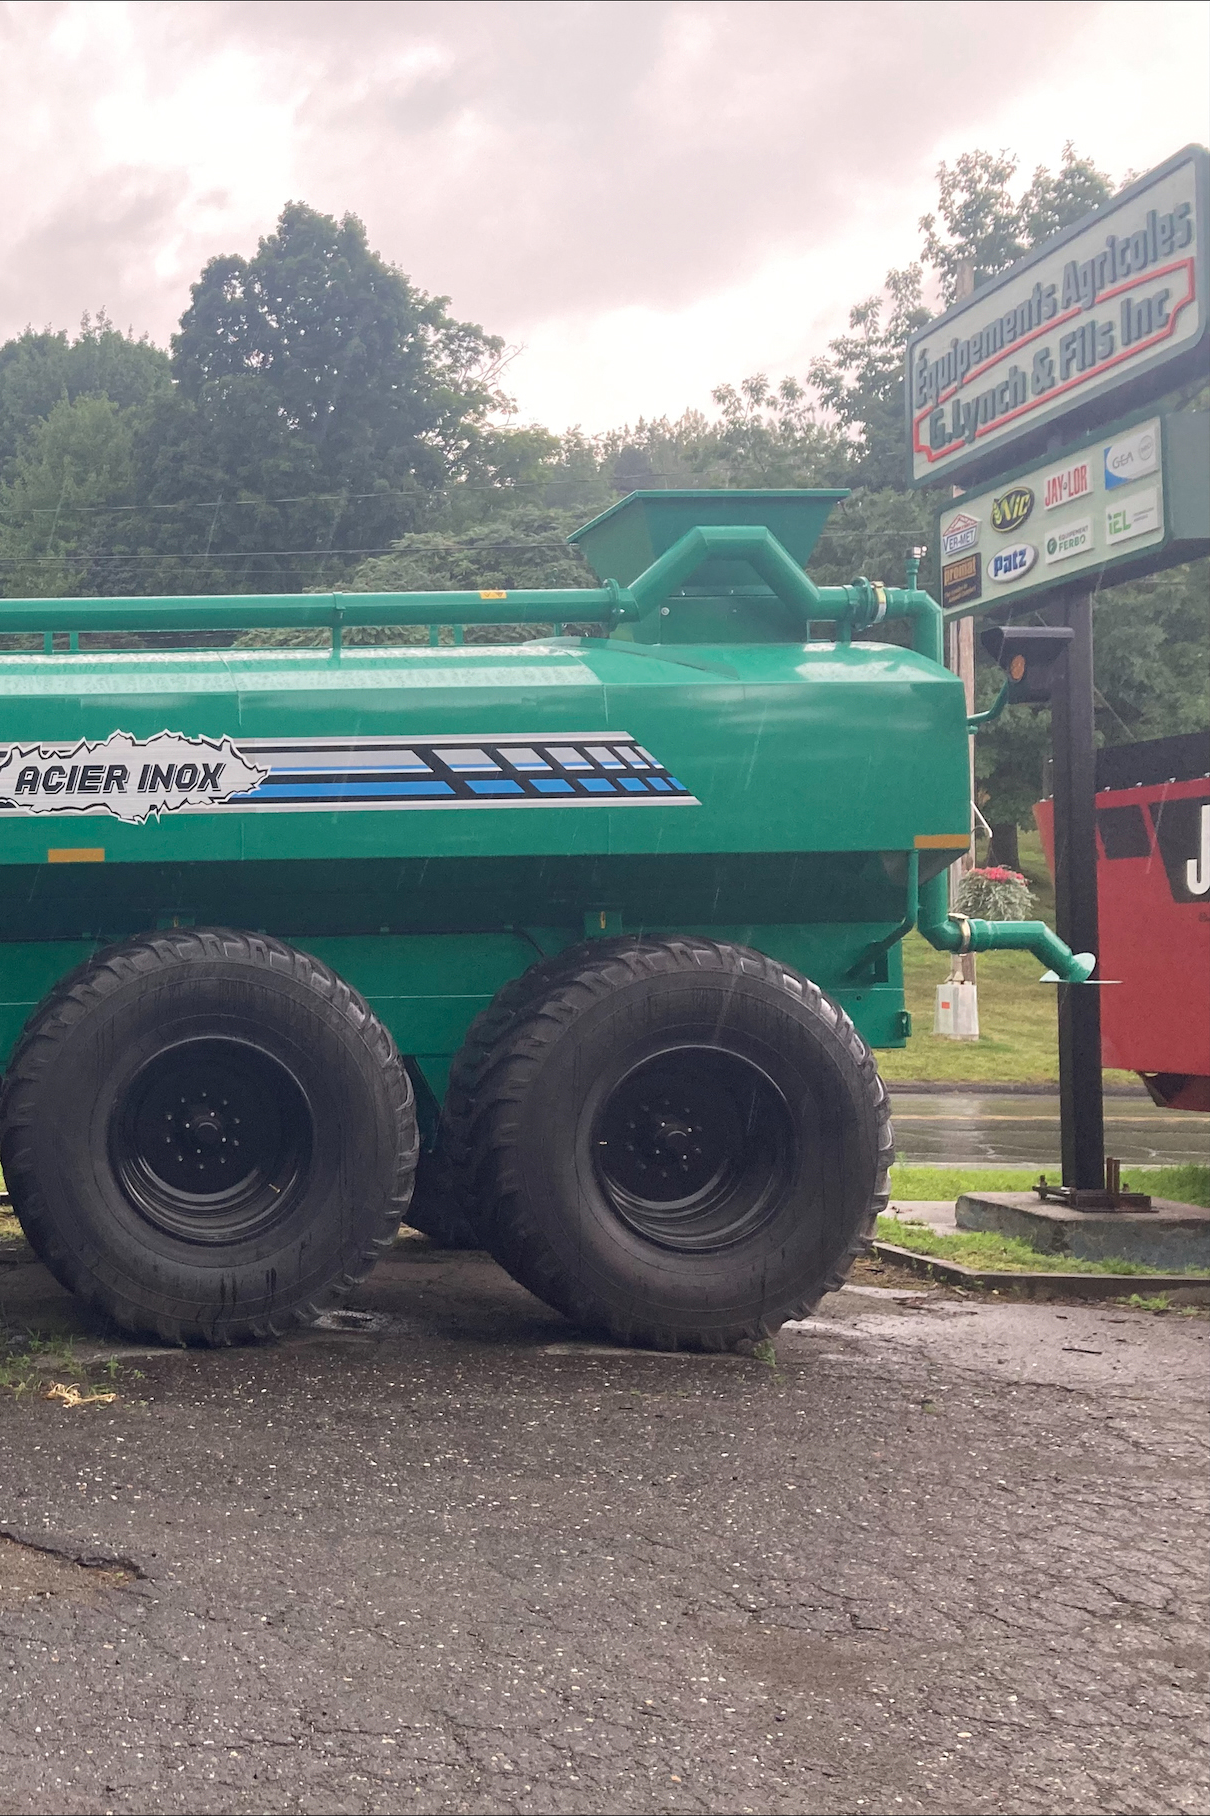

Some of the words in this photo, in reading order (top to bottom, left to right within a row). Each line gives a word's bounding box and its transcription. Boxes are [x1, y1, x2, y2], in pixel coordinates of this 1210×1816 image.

[915, 282, 1058, 409] Équipements
[1061, 201, 1192, 311] Agricoles
[1031, 347, 1055, 395] &
[1059, 319, 1115, 381] Fils
[1120, 288, 1171, 346] Inc
[1112, 451, 1134, 469] GEA
[1000, 493, 1031, 521] Nic
[943, 529, 974, 552] VER-MET
[1058, 534, 1087, 553] FERBO
[944, 556, 977, 587] promat
[14, 763, 131, 795] ACIER
[137, 762, 226, 793] INOX
